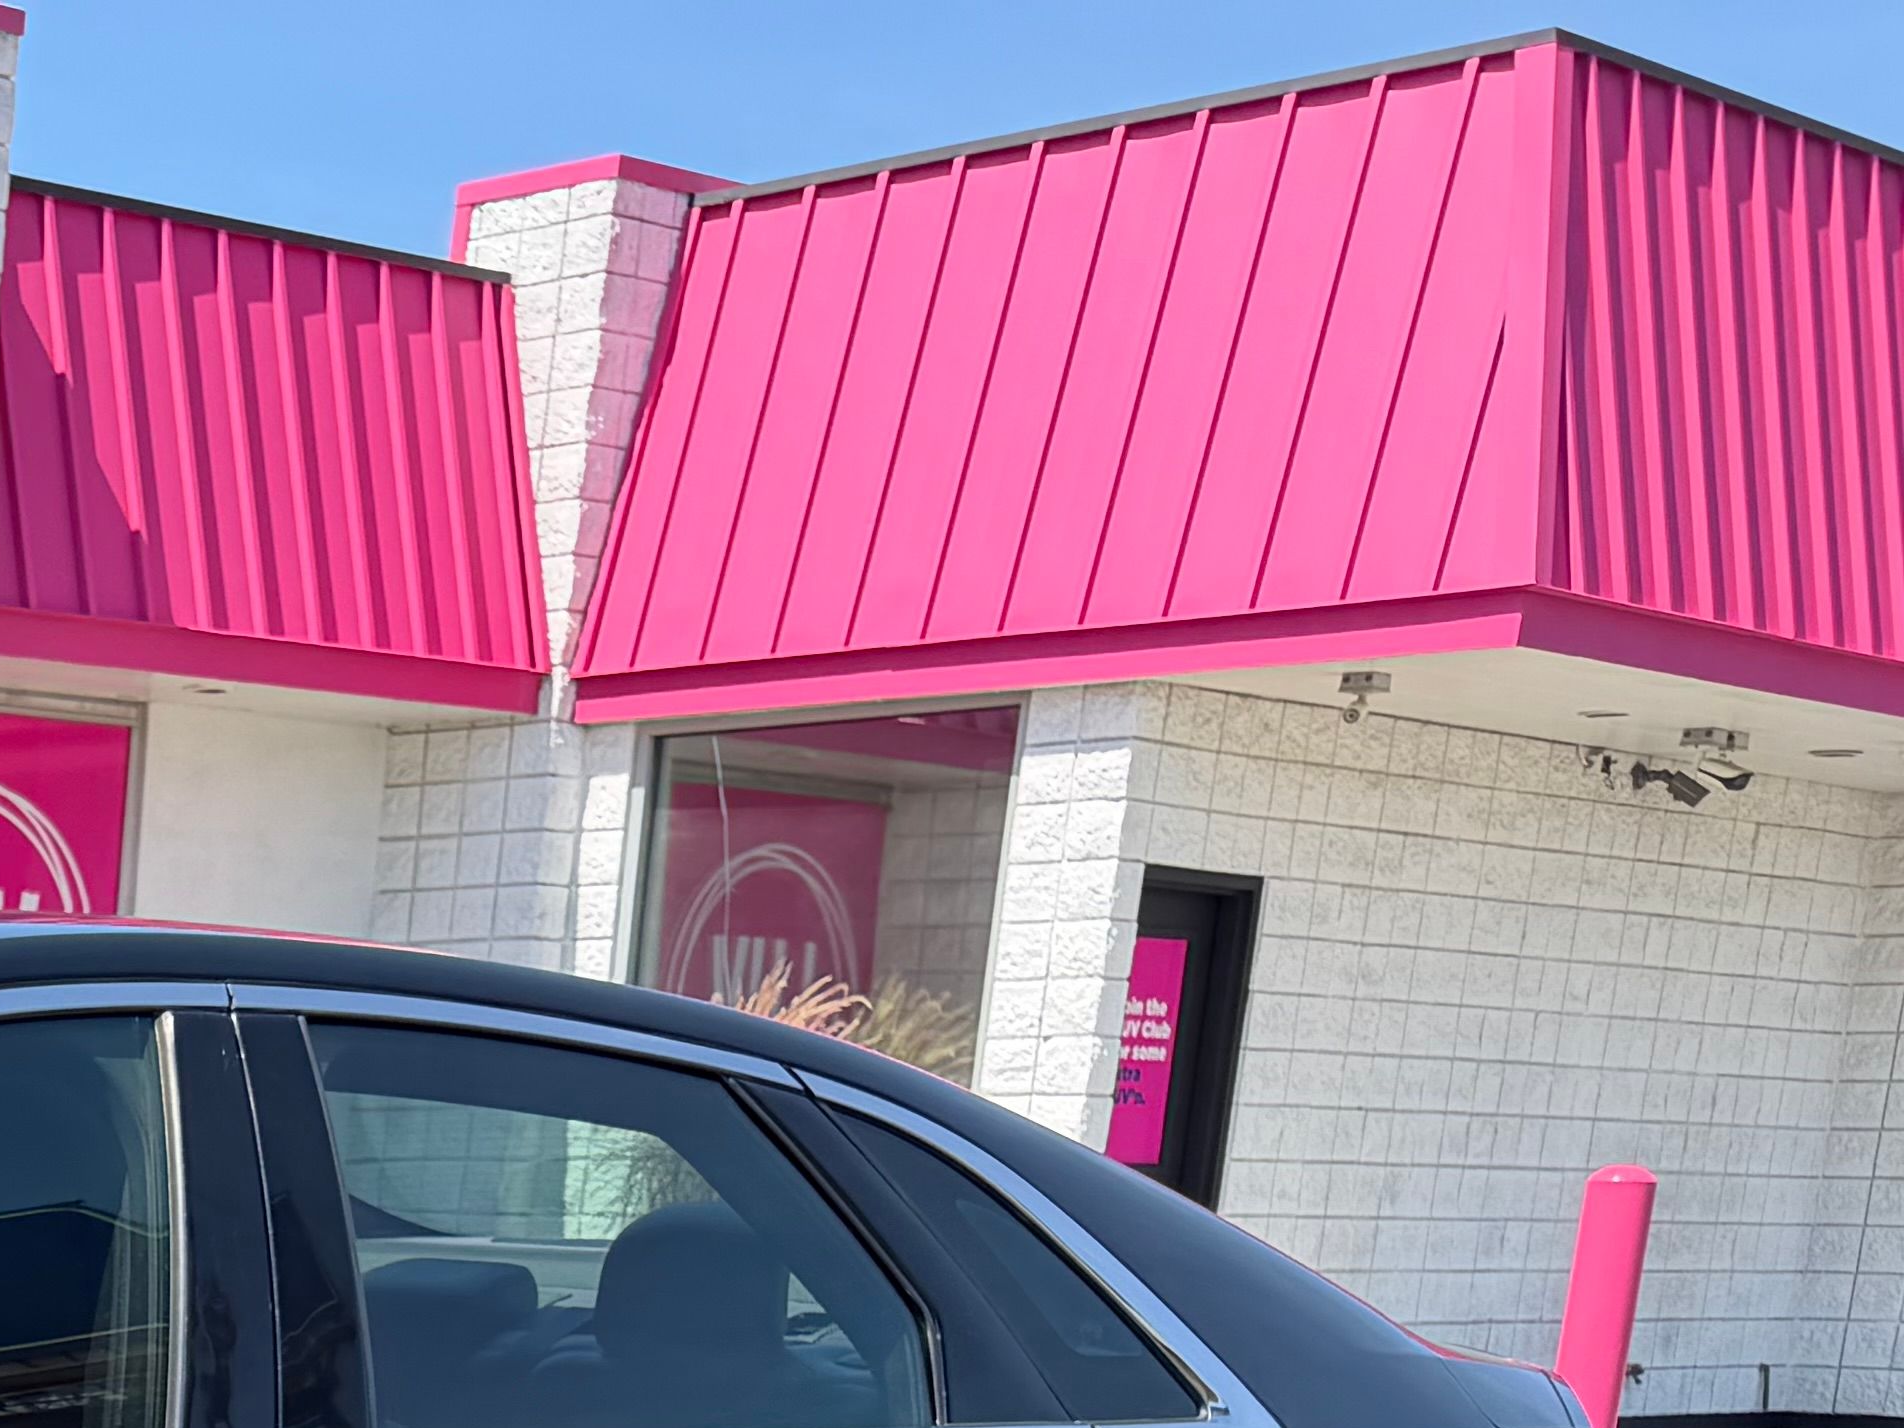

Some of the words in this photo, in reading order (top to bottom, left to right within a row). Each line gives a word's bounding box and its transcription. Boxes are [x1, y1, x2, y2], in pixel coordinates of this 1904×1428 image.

[1146, 997, 1168, 1017] the
[1141, 1019, 1171, 1039] Club
[1131, 1045, 1167, 1062] some
